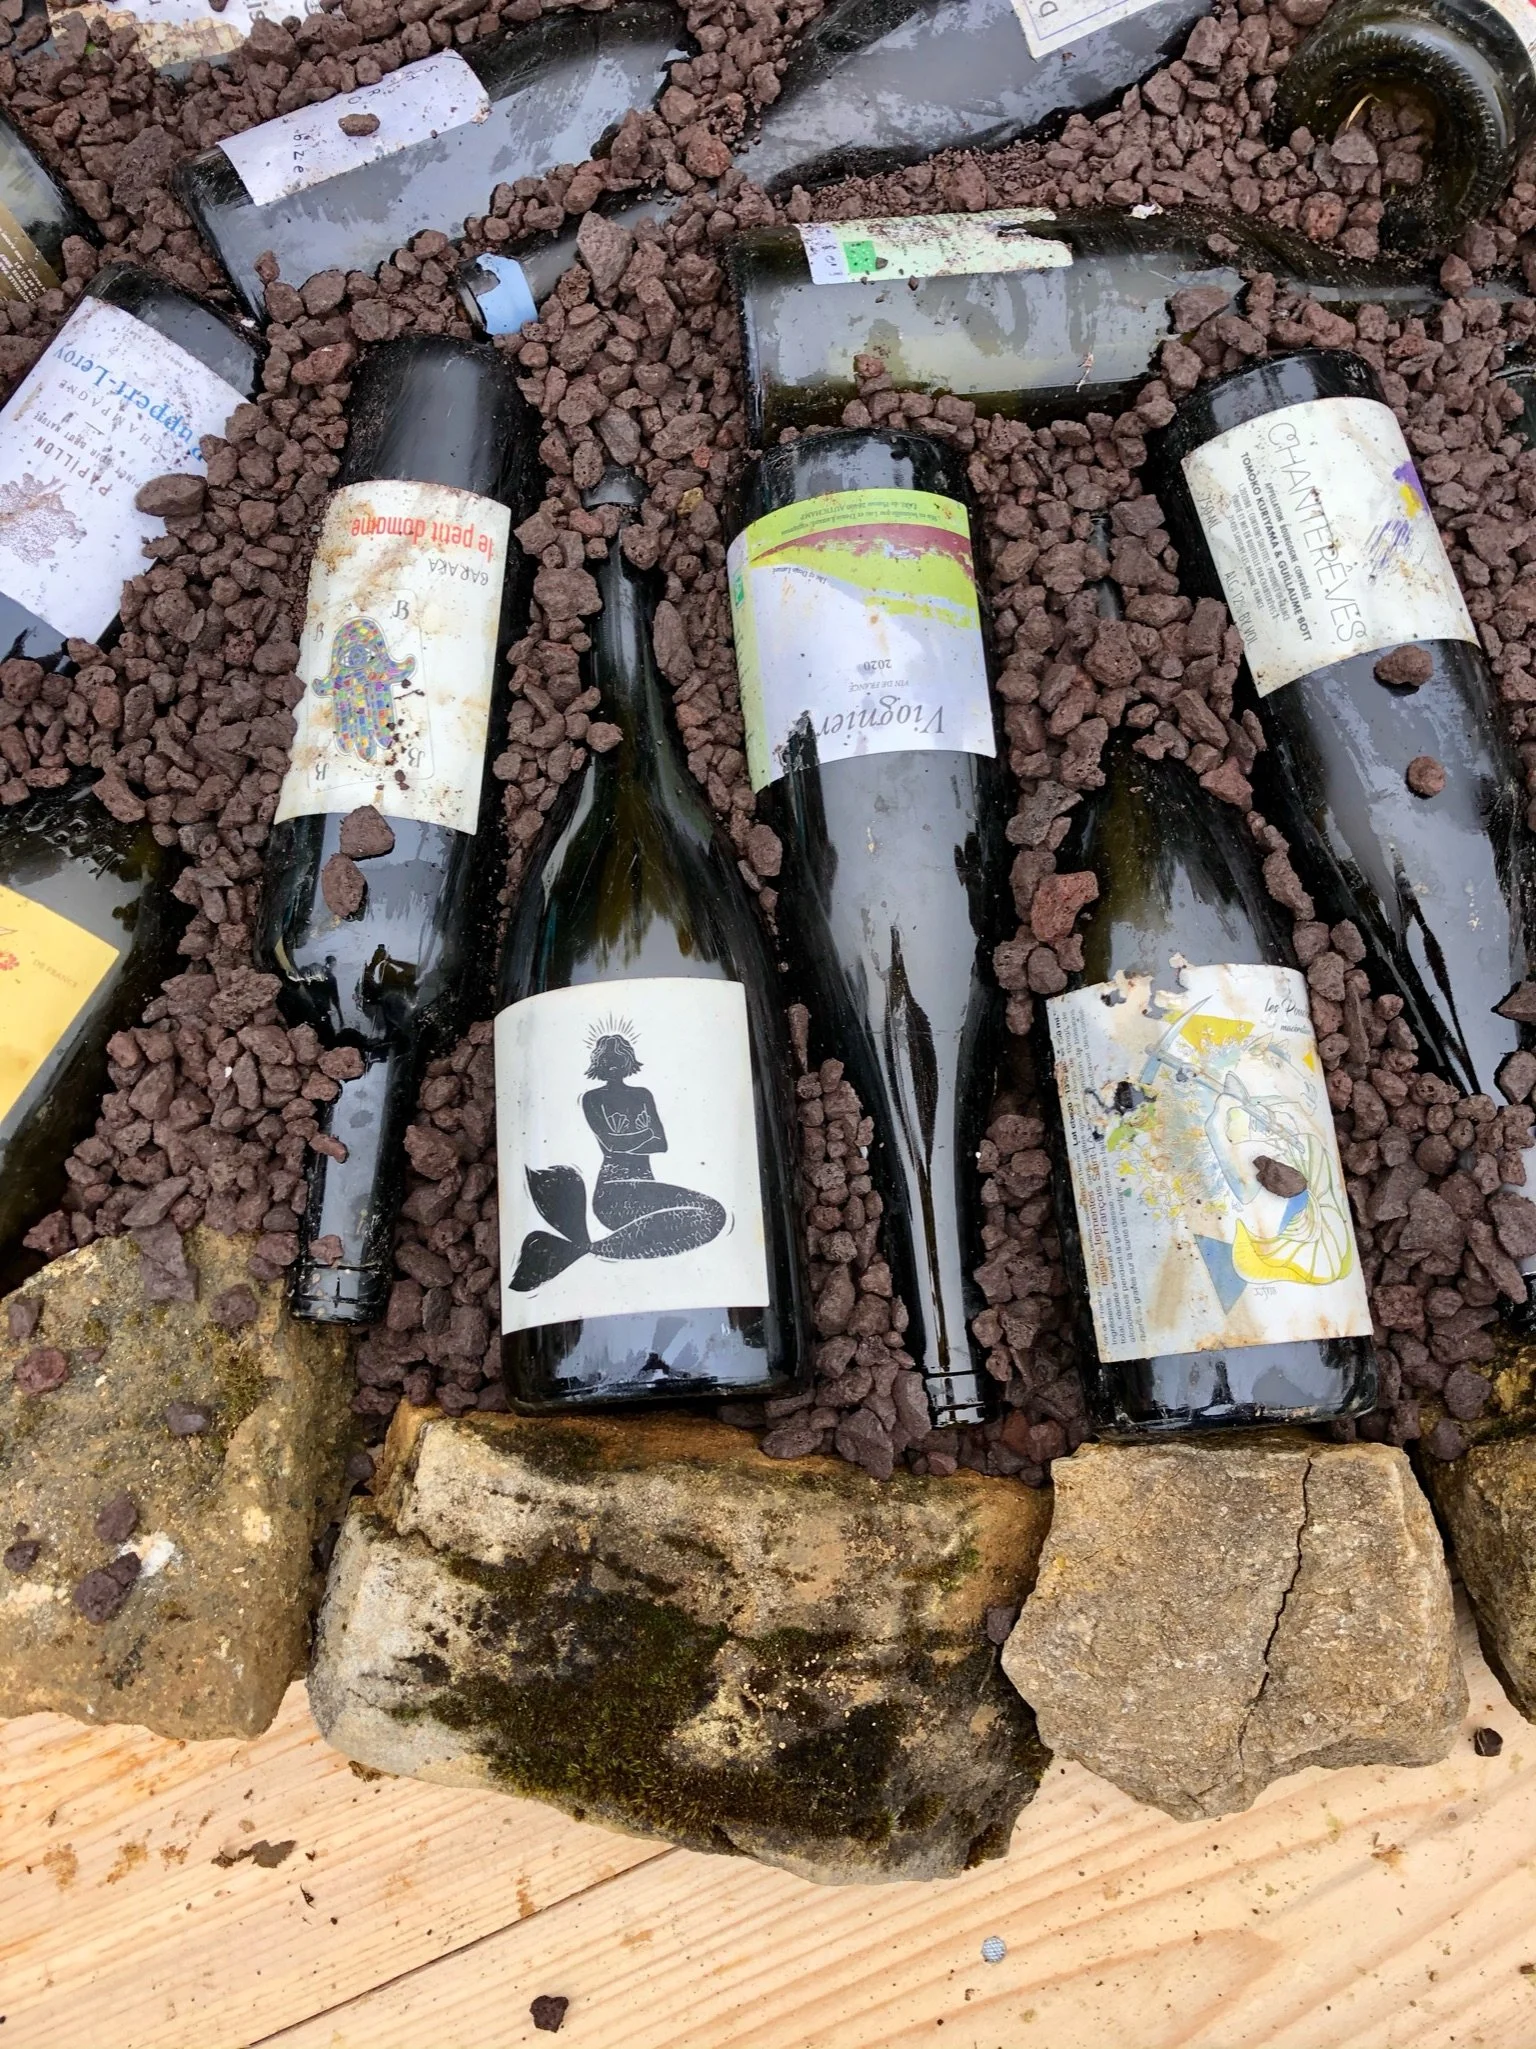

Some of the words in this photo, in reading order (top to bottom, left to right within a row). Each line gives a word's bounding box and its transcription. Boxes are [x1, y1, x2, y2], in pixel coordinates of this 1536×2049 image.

[32, 412, 62, 432] NATURE
[57, 377, 164, 454] CHAMPAGNE
[62, 430, 87, 449] BRUT
[32, 435, 113, 497] PAPILLON
[1239, 451, 1262, 495] TOMOKO
[350, 512, 425, 545] domaine
[430, 520, 474, 549] petit
[1254, 496, 1280, 548] KURIYAMA
[1267, 421, 1368, 643] CHANTERÊVES
[477, 534, 494, 562] le
[1263, 482, 1284, 522] APPELLATION
[1277, 523, 1299, 563] BOURGOGNE
[1292, 564, 1313, 601] CONTRÔLÉE
[1273, 549, 1283, 558] &
[427, 557, 488, 585] BARAKA
[1275, 559, 1304, 615] GUILLAUME
[1295, 616, 1313, 642] BOTT
[862, 659, 892, 670] 2020
[848, 680, 880, 691] FRANCE
[881, 680, 893, 688] DE
[815, 695, 943, 735] Viognier
[1101, 1170, 1111, 1196] même
[1087, 1190, 1102, 1244] fermentés
[1093, 1185, 1109, 1233] François
[1121, 1228, 1131, 1250] santé
[1094, 1249, 1108, 1285] raisins
[1116, 1256, 1128, 1291] pendant
[1129, 1276, 1141, 1304] graves
[1121, 1294, 1135, 1342] alcoolisées
